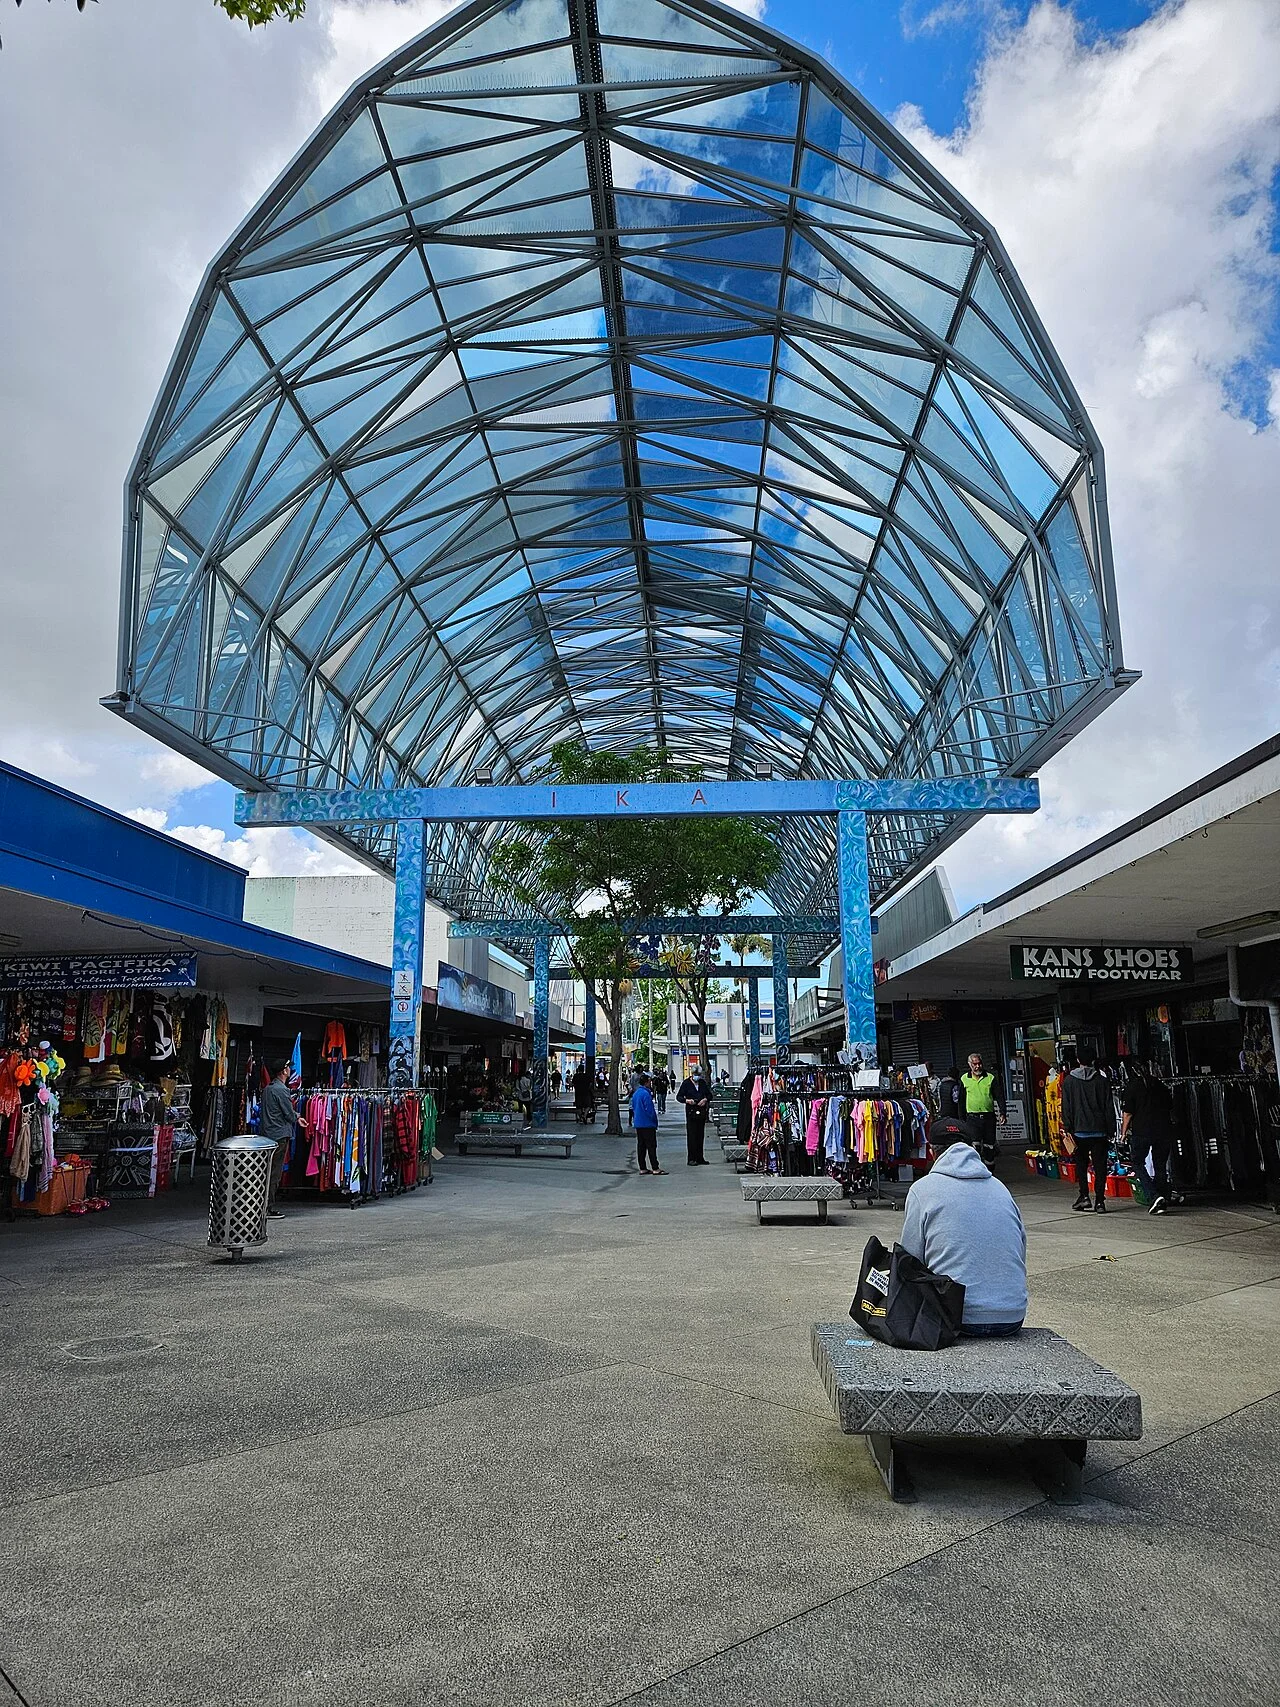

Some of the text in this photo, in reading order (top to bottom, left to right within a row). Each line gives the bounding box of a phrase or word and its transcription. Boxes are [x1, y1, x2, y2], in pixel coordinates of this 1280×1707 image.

[1022, 947, 1180, 968] KANS SHOES
[4, 958, 177, 971] KIWI PACIFIKA
[6, 970, 69, 978] GENERAL
[74, 976, 117, 984] Culture
[121, 974, 164, 983] Together
[1024, 967, 1182, 980] FAMILY FOOTWEAR
[918, 1005, 937, 1014] Lotto
